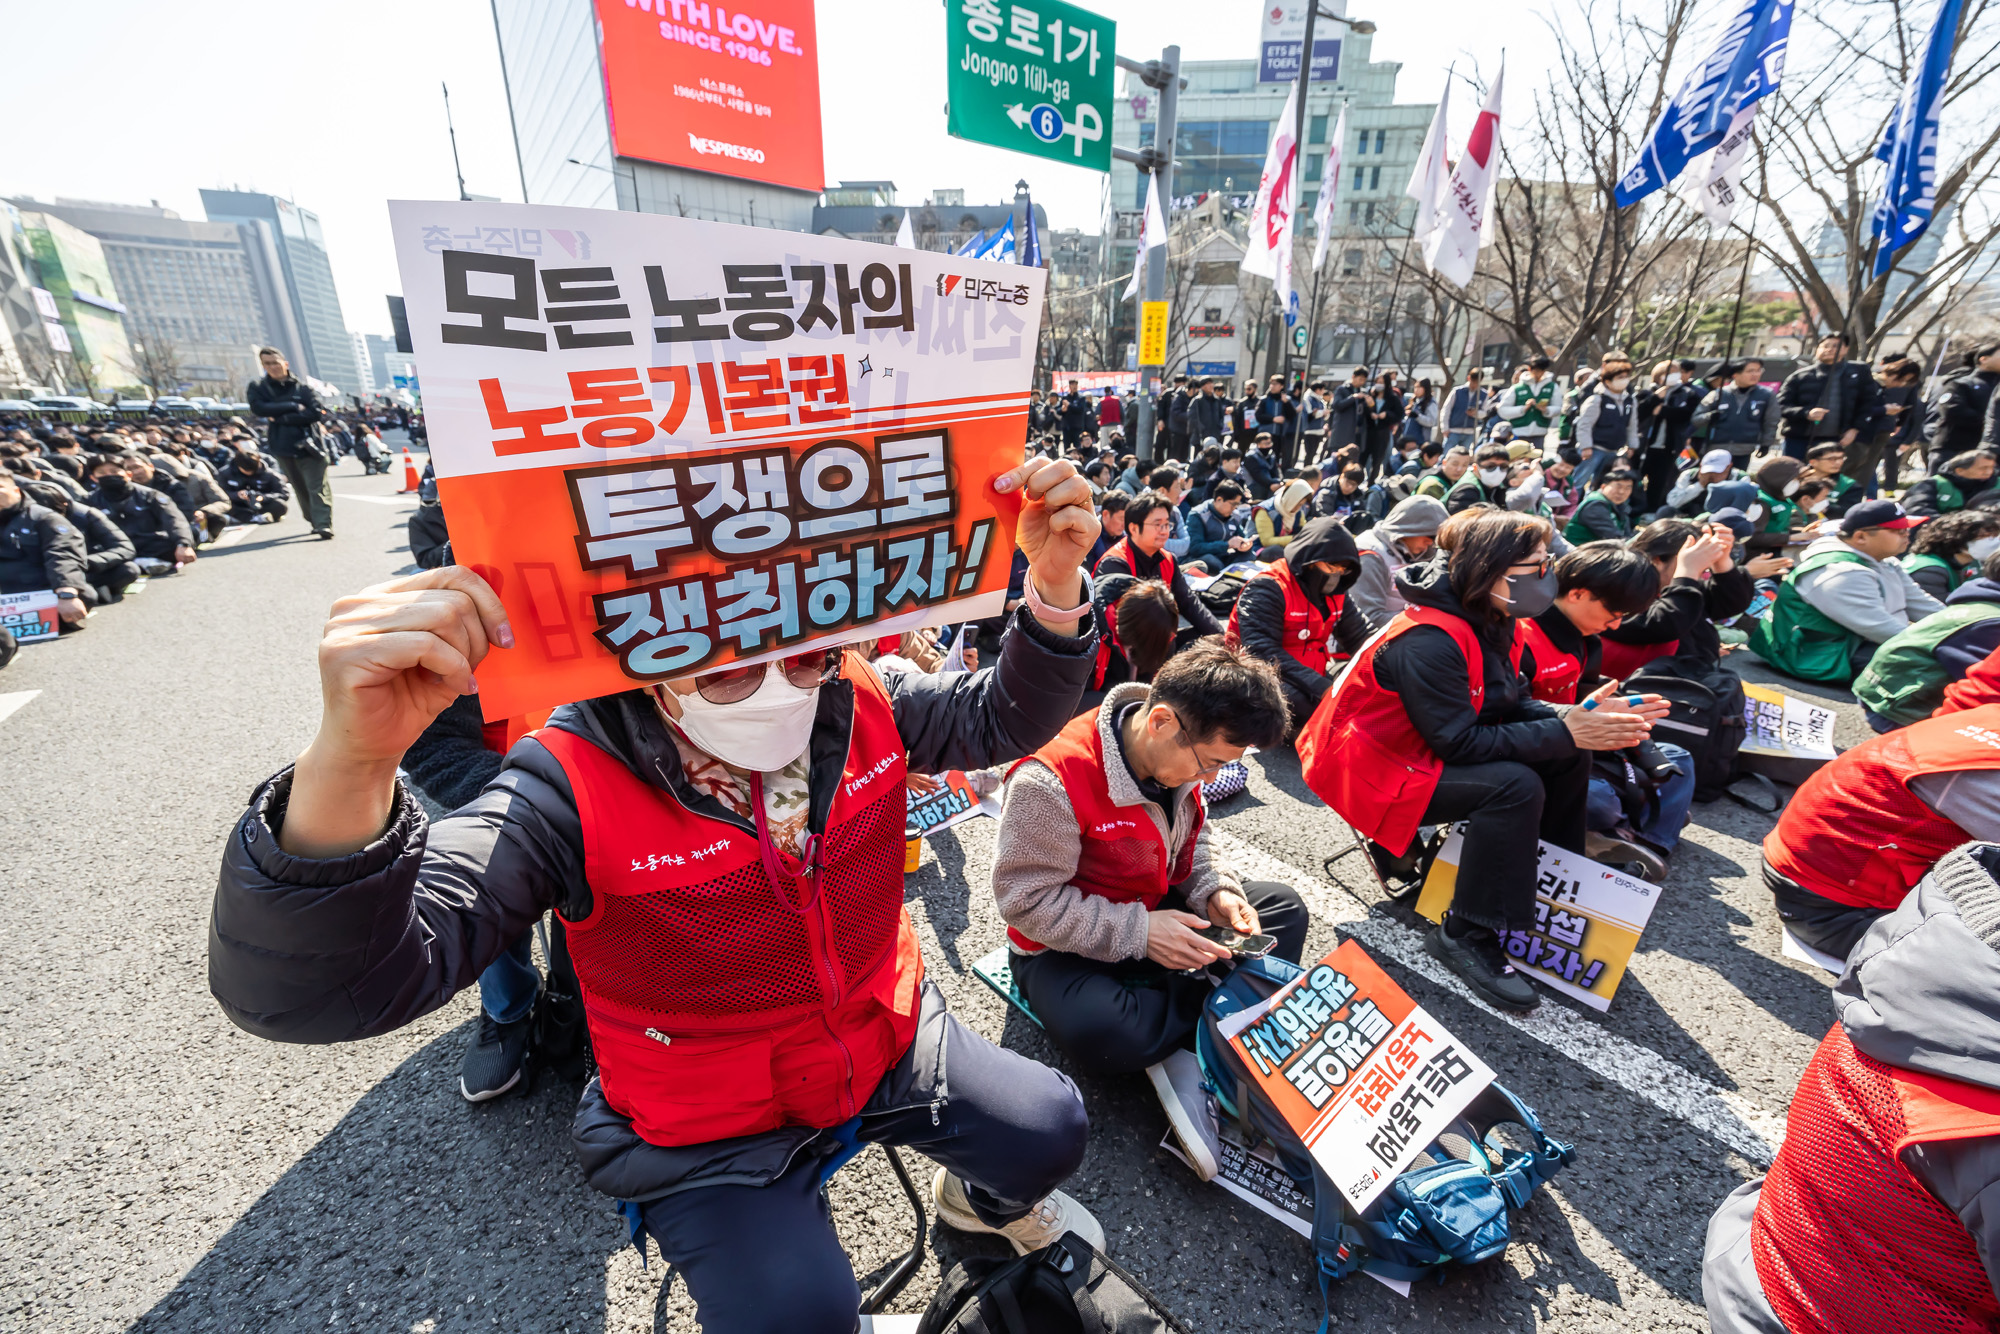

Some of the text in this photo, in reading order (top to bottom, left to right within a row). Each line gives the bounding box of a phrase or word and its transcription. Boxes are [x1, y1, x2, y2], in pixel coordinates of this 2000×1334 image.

[659, 21, 772, 67] SINCE 1986
[716, 7, 803, 56] LOVE.
[962, 0, 1101, 77] 종로1가
[1267, 45, 1288, 57] ETS
[961, 43, 1070, 104] Jongno 1(il)-ga
[1266, 57, 1299, 70] TOEFL
[687, 131, 765, 164] NESPRESSO
[1041, 111, 1054, 137] 6
[441, 249, 915, 352] 모든 노동자의
[964, 276, 1031, 307] 민주노총
[478, 353, 852, 457] 노동기본권
[566, 429, 954, 578] 투쟁으로
[597, 519, 994, 678] 쟁취하자!
[630, 838, 731, 872] 노동자는 하나다
[1614, 876, 1651, 897] 민주노총
[1497, 927, 1606, 989] 하자!
[1240, 964, 1358, 1078] 쟁취하자!
[1281, 997, 1396, 1112] 투쟁으로
[1350, 1020, 1434, 1118] 노동기본권
[1365, 1044, 1474, 1170] 모든 노동자의
[1248, 1157, 1270, 1175] 시도
[1348, 1173, 1373, 1200] 민주노총
